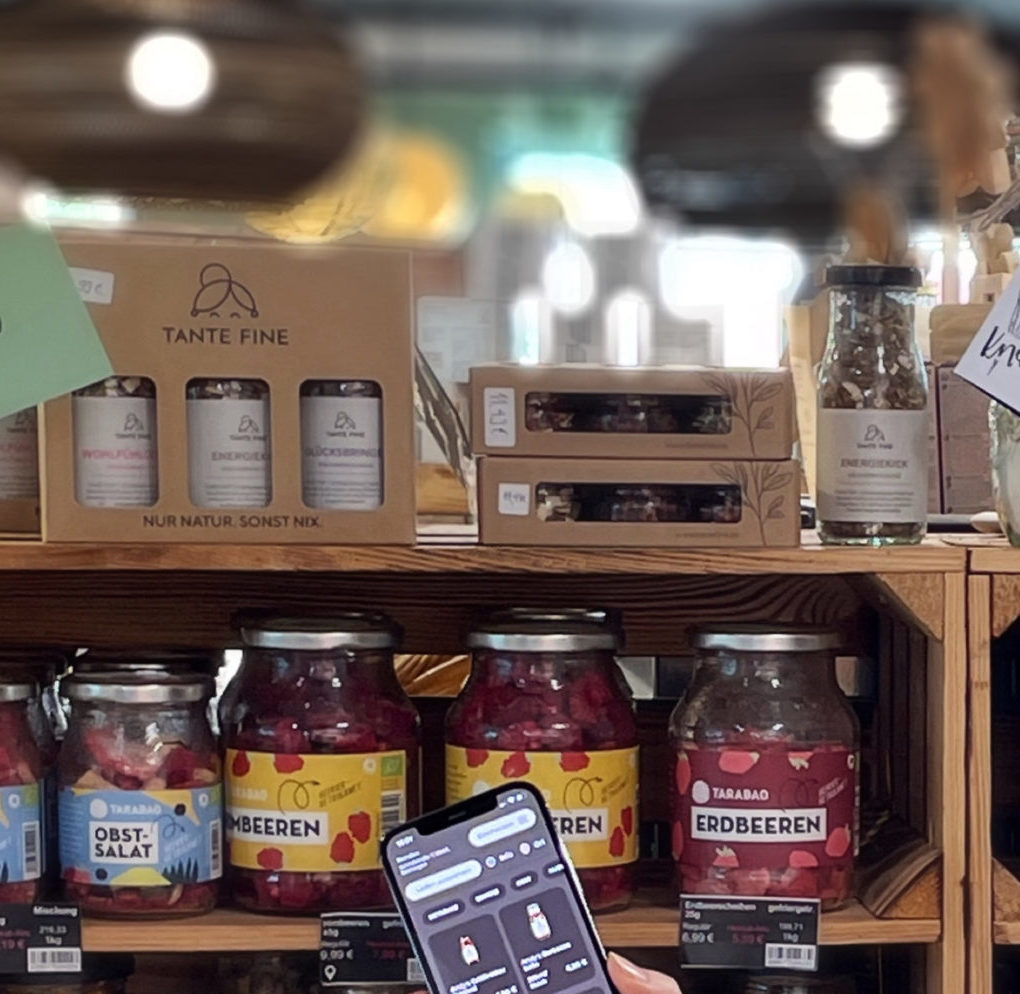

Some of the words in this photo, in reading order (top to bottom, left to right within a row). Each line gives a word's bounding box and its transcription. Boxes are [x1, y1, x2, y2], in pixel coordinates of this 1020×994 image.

[162, 326, 231, 345] TANTE
[239, 328, 290, 346] FINE
[142, 514, 177, 528] NUR
[239, 515, 289, 528] SONST
[712, 786, 769, 801] TARABAO
[696, 814, 821, 835] ERDBEEREN
[94, 826, 149, 843] OBST-
[94, 843, 153, 859] SALAT
